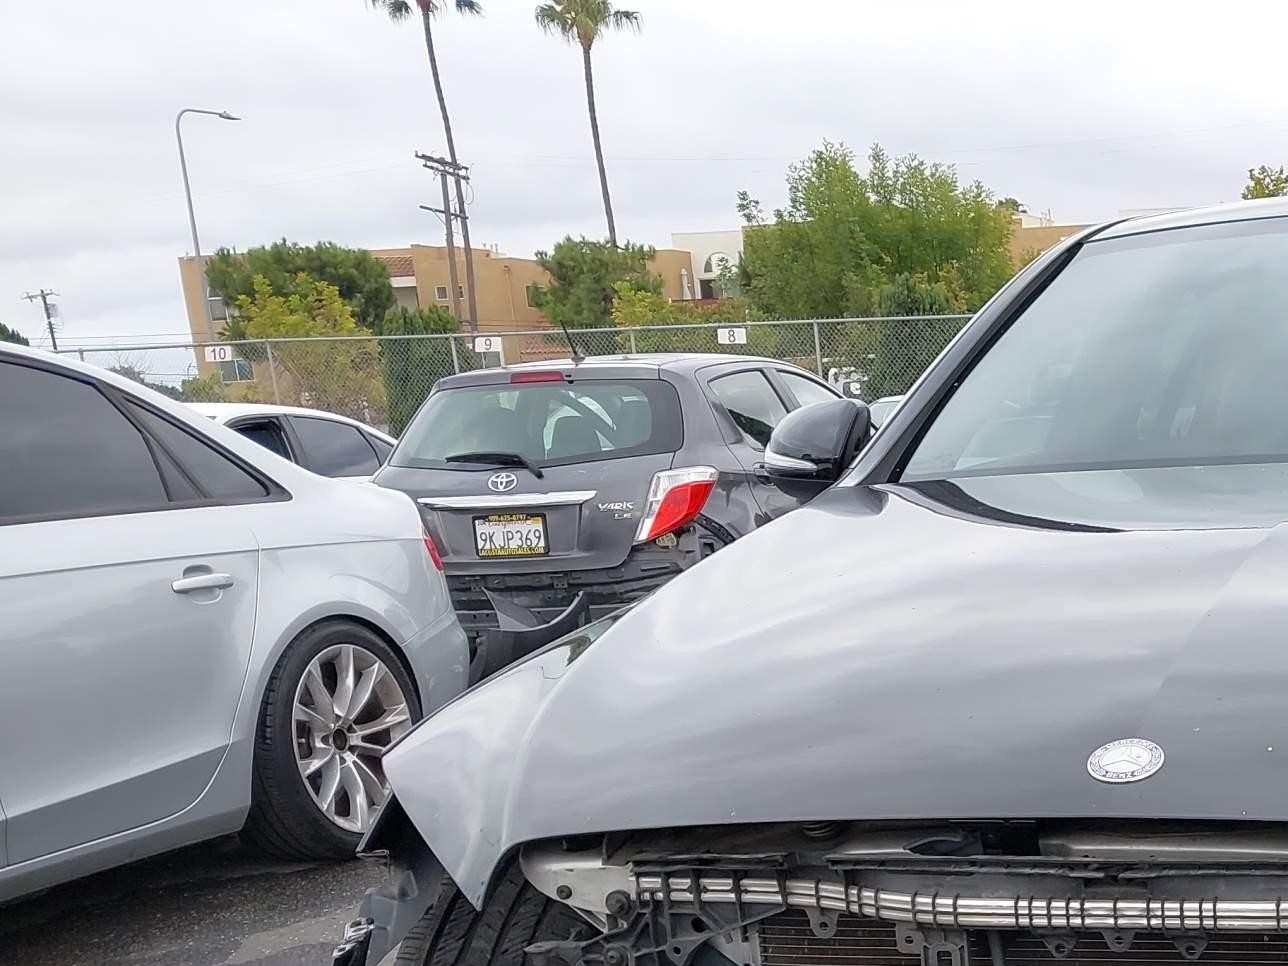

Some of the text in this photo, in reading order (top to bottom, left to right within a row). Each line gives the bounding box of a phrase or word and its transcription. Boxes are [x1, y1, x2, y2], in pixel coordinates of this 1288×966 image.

[727, 329, 736, 343] 8
[484, 338, 492, 351] 9
[210, 347, 226, 361] 10
[598, 501, 634, 512] YARIS
[479, 529, 542, 549] 9KJP369
